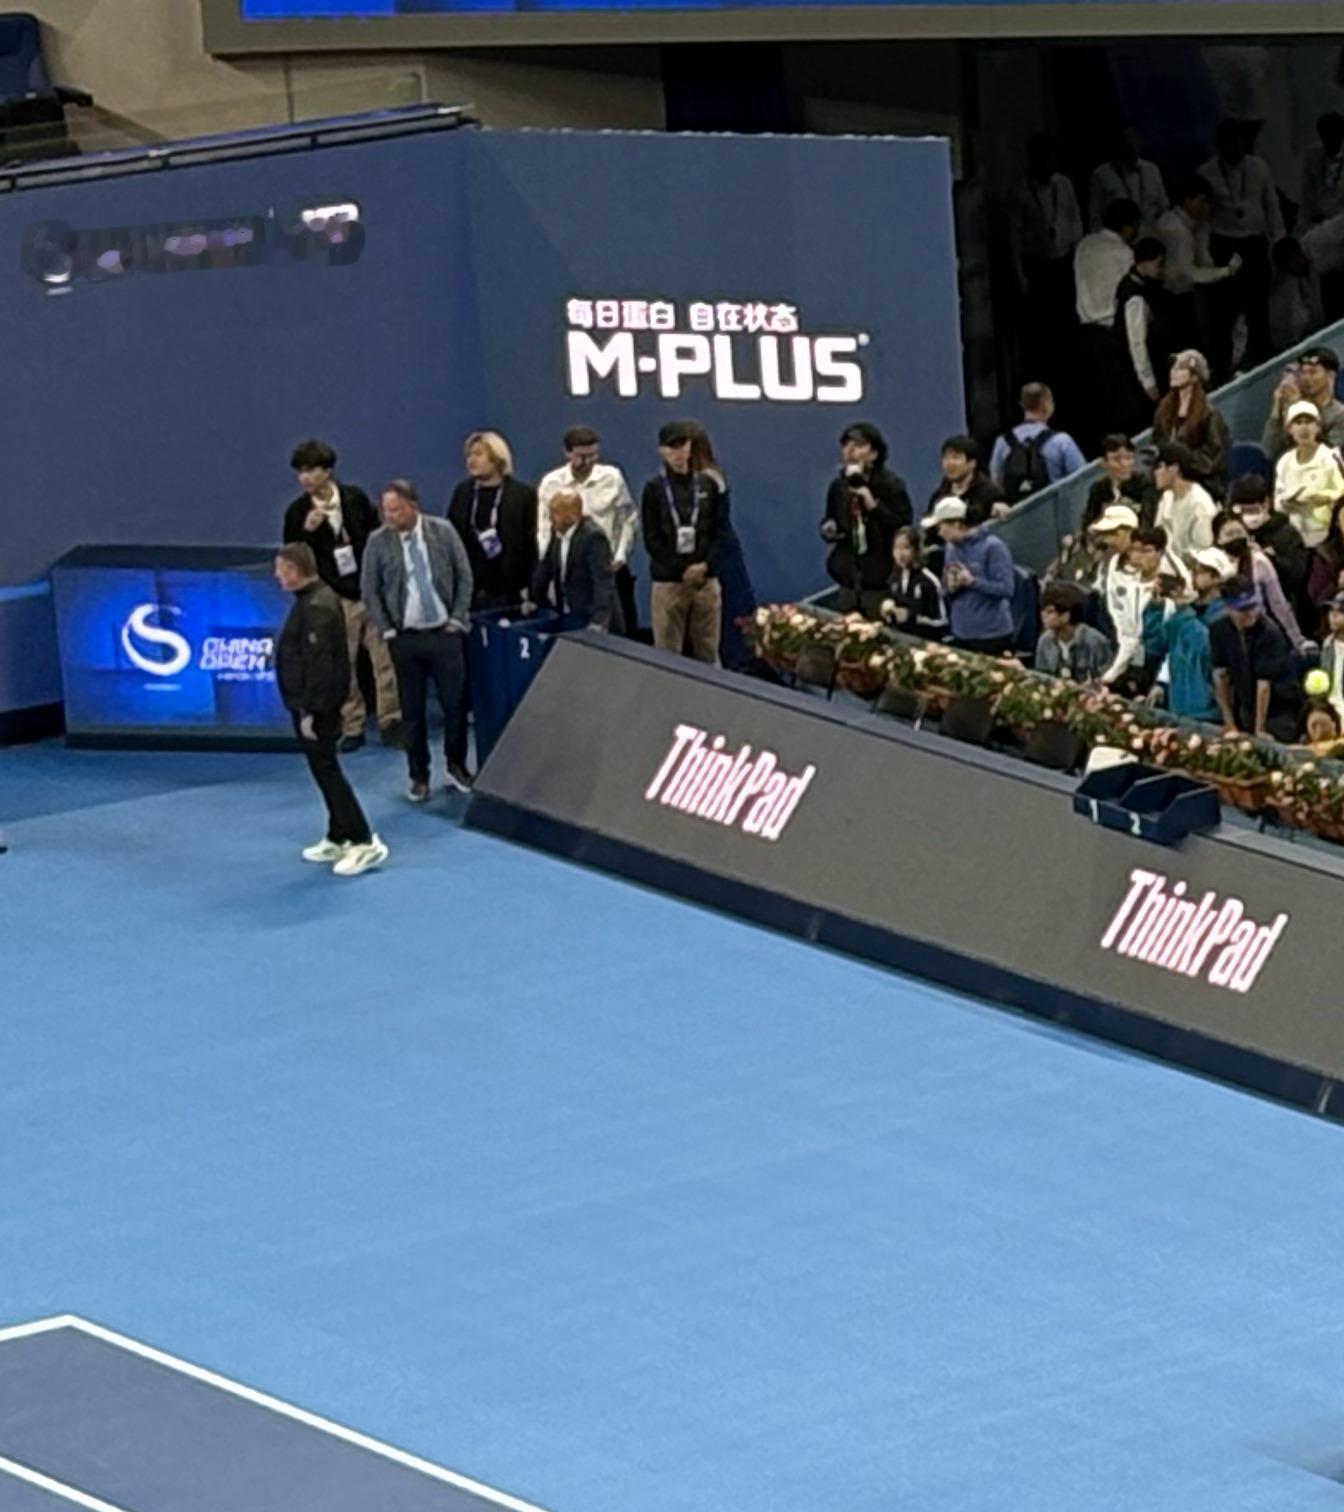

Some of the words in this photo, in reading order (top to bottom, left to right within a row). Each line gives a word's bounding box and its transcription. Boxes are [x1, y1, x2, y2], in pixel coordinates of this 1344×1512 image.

[520, 636, 531, 659] 2
[645, 723, 817, 842] ThinkPad
[1088, 799, 1099, 824] 1
[1128, 812, 1142, 836] 2
[1101, 869, 1288, 993] ThinkPad
